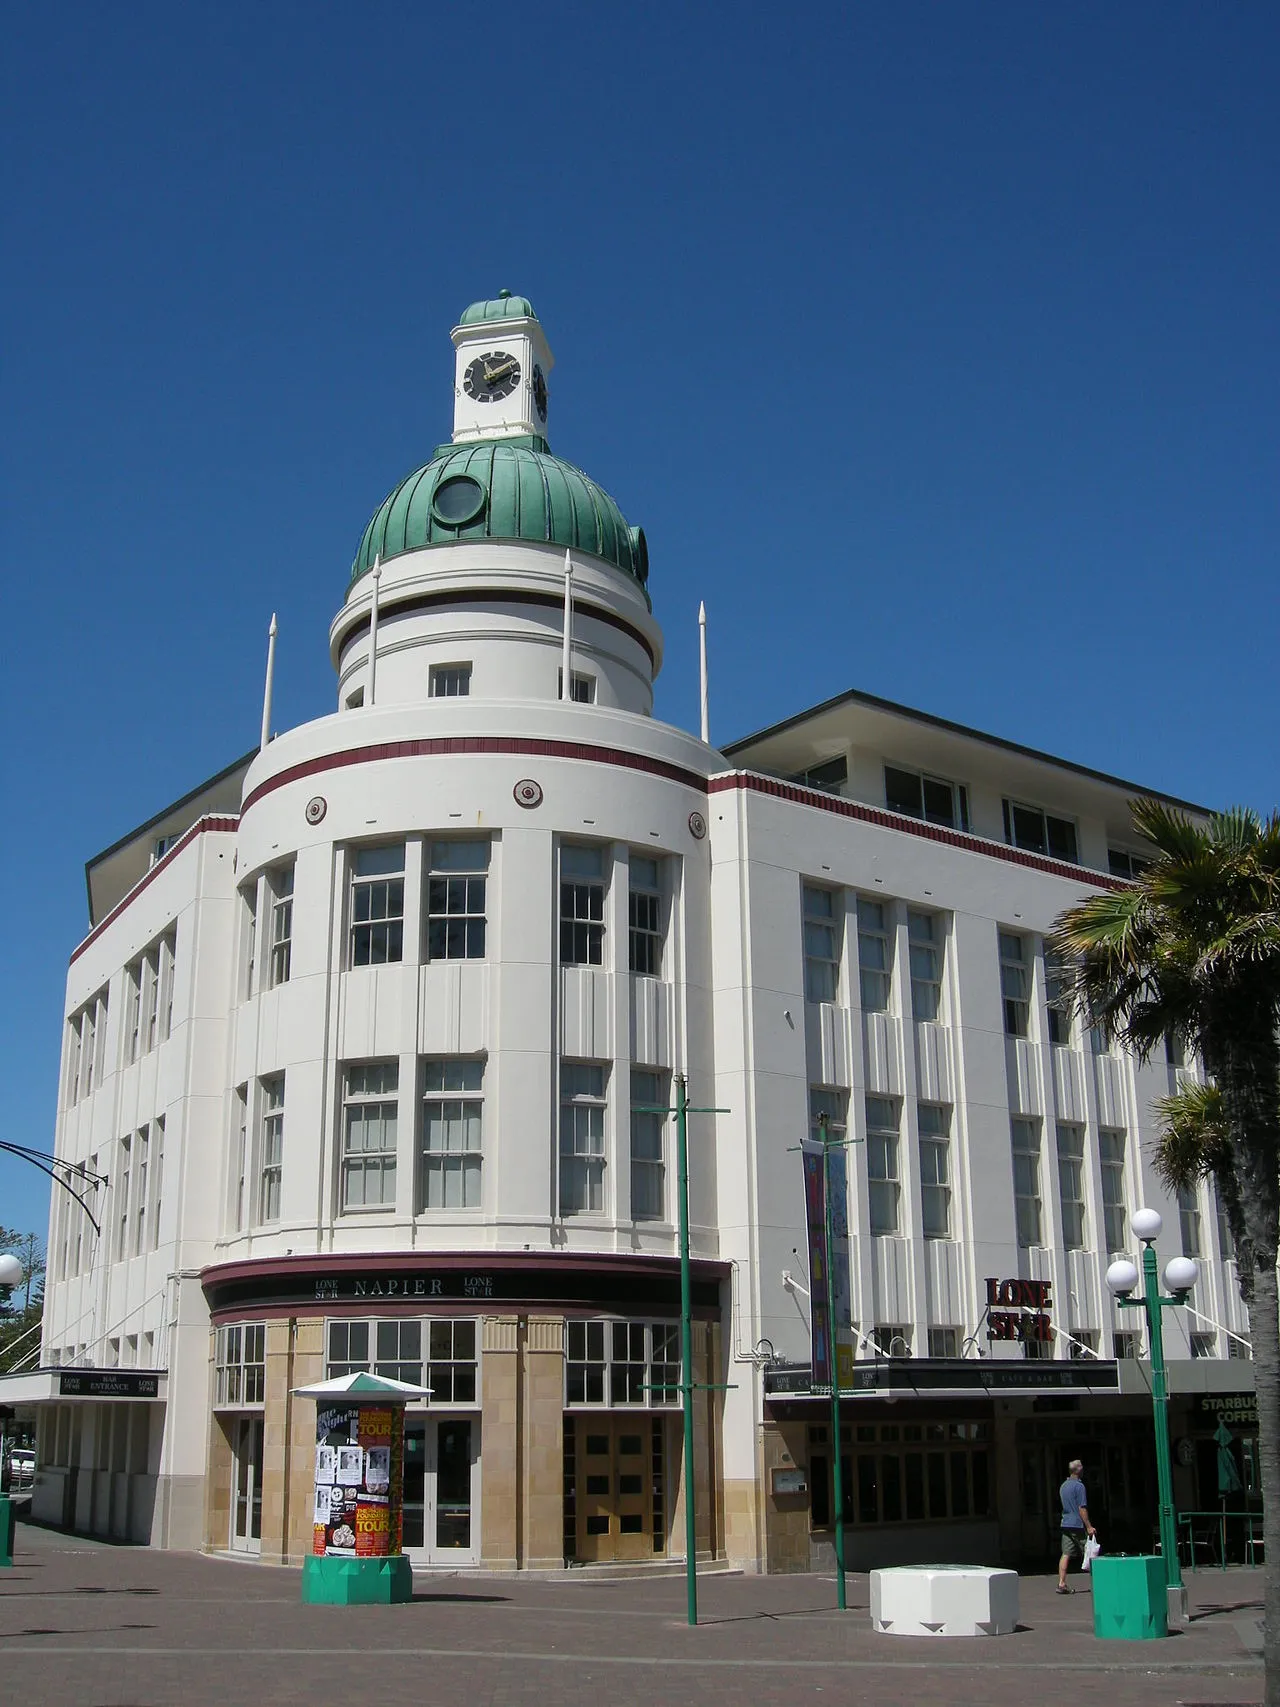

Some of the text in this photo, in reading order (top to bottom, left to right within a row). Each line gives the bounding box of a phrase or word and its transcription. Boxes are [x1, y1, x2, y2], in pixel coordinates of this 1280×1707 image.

[315, 1279, 339, 1289] LONE
[354, 1279, 442, 1296] NAPIER
[464, 1277, 493, 1287] LONE
[984, 1278, 1053, 1308] LONE
[90, 1382, 129, 1391] ENTRANCE
[360, 1424, 391, 1435] TOUR
[357, 1521, 389, 1532] TOUR
